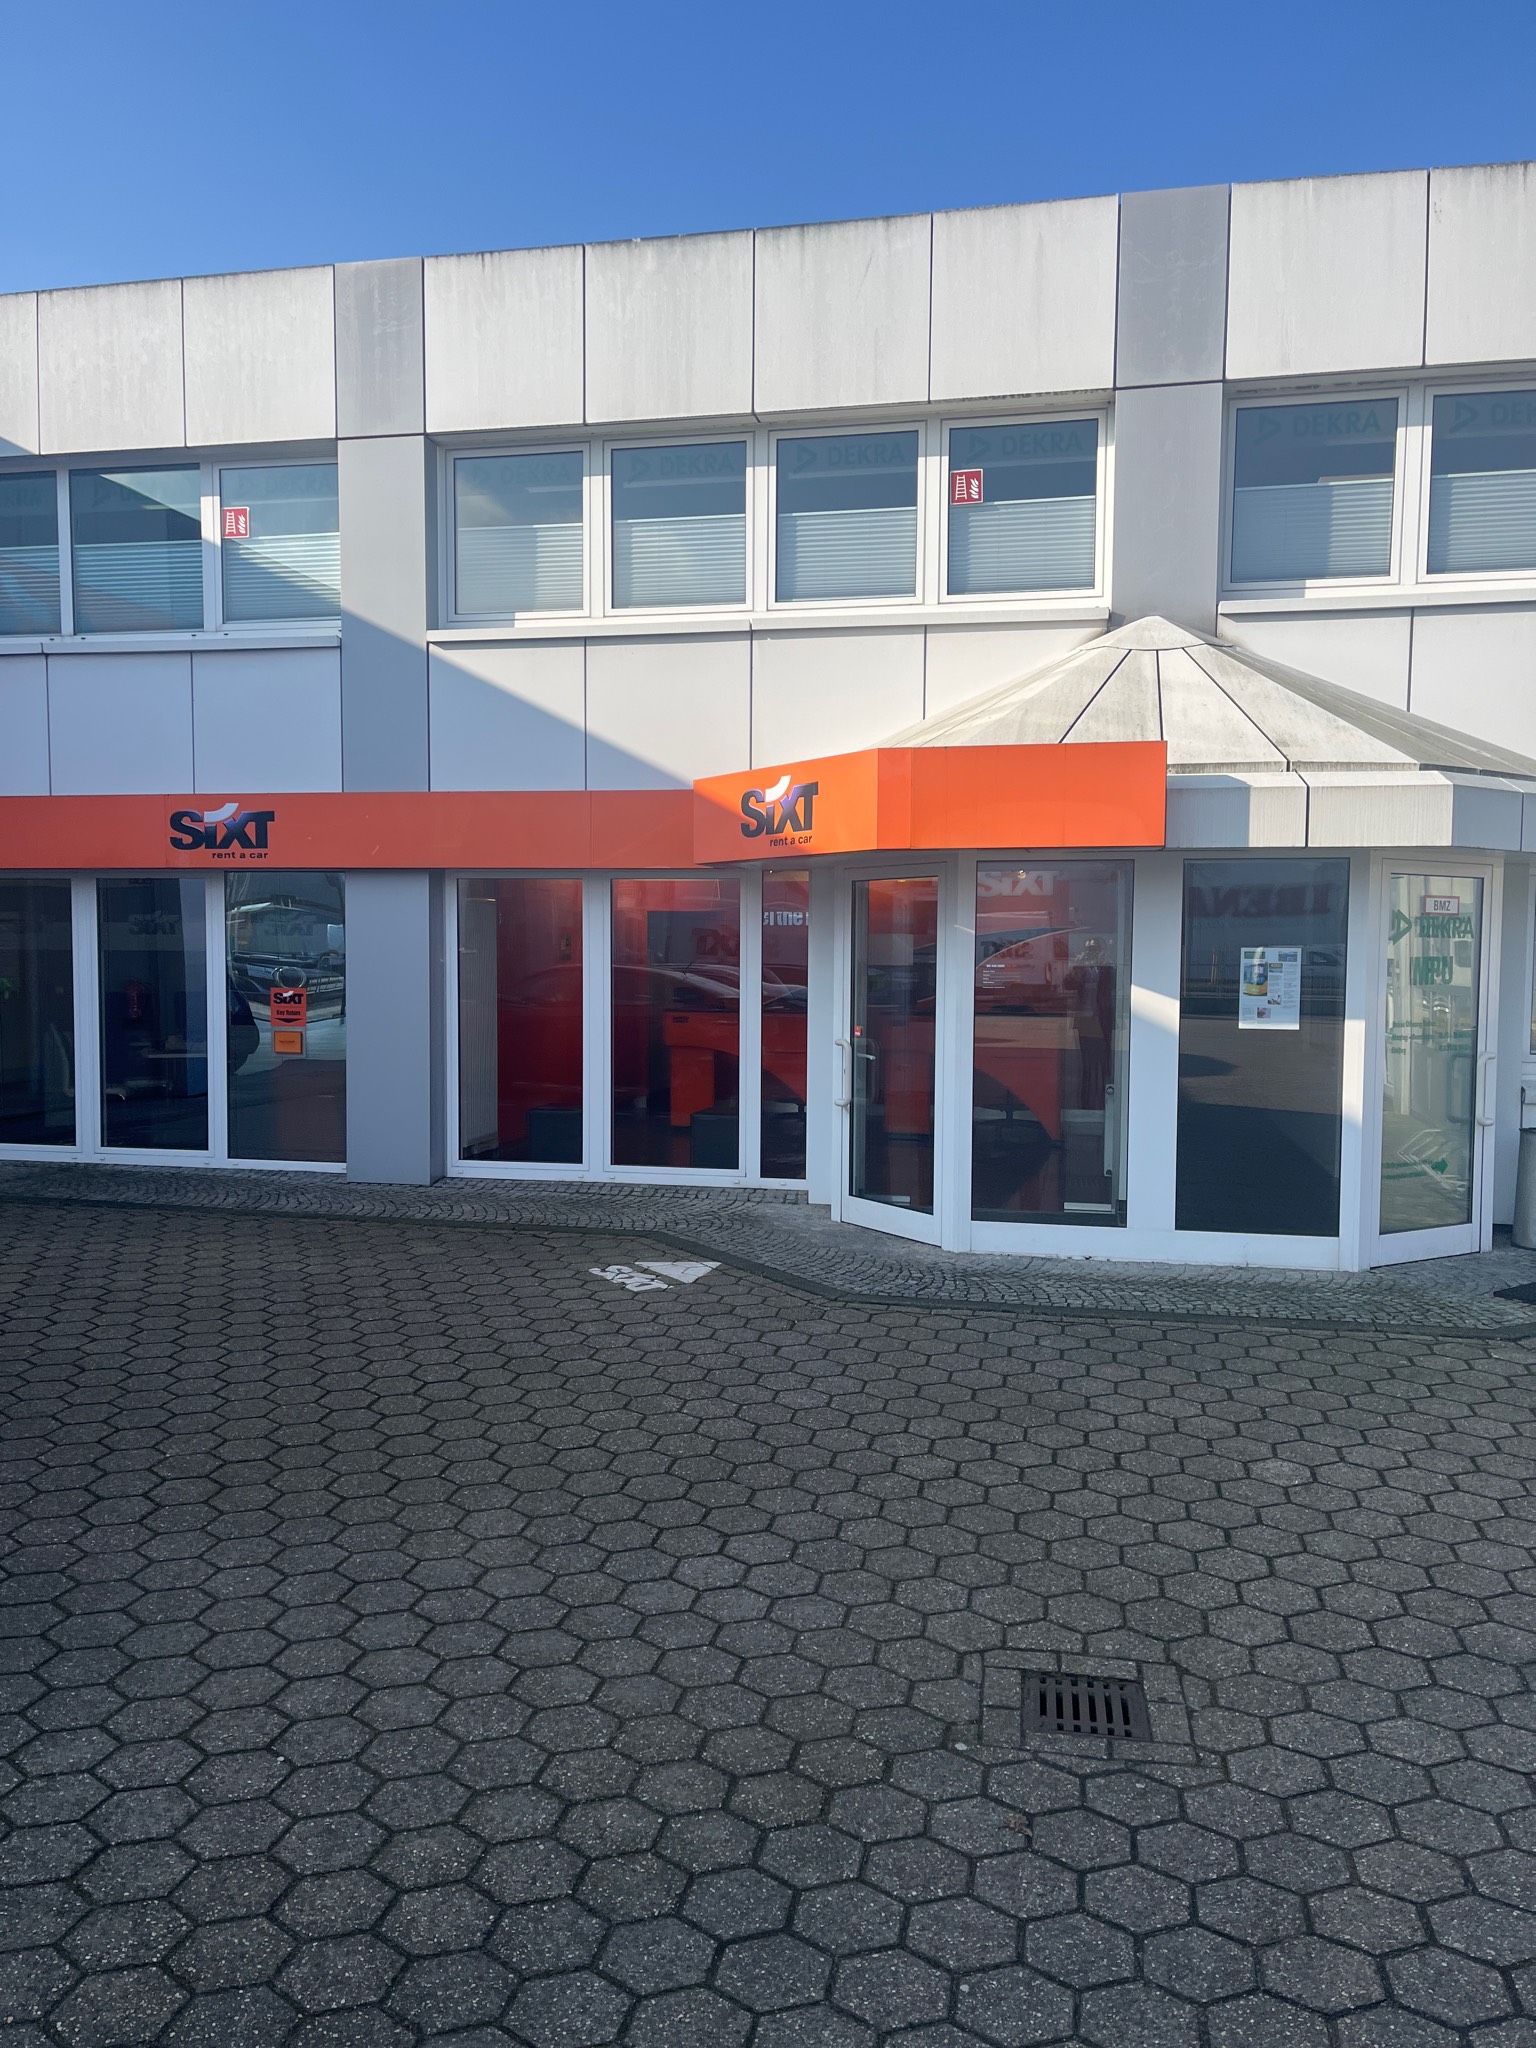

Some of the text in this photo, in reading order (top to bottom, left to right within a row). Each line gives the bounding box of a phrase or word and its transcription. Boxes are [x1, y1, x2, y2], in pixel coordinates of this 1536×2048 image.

[1293, 410, 1381, 437] DEKRA
[827, 441, 906, 468] DEKRA
[1002, 430, 1082, 457] DEKRA
[500, 460, 572, 486] DEKRA
[659, 450, 736, 477] DEKRA
[740, 775, 818, 838] SIXT
[169, 802, 275, 850] SIXT
[769, 835, 813, 847] rent a car
[1433, 900, 1451, 911] BMZ
[273, 990, 304, 1004] SIXT
